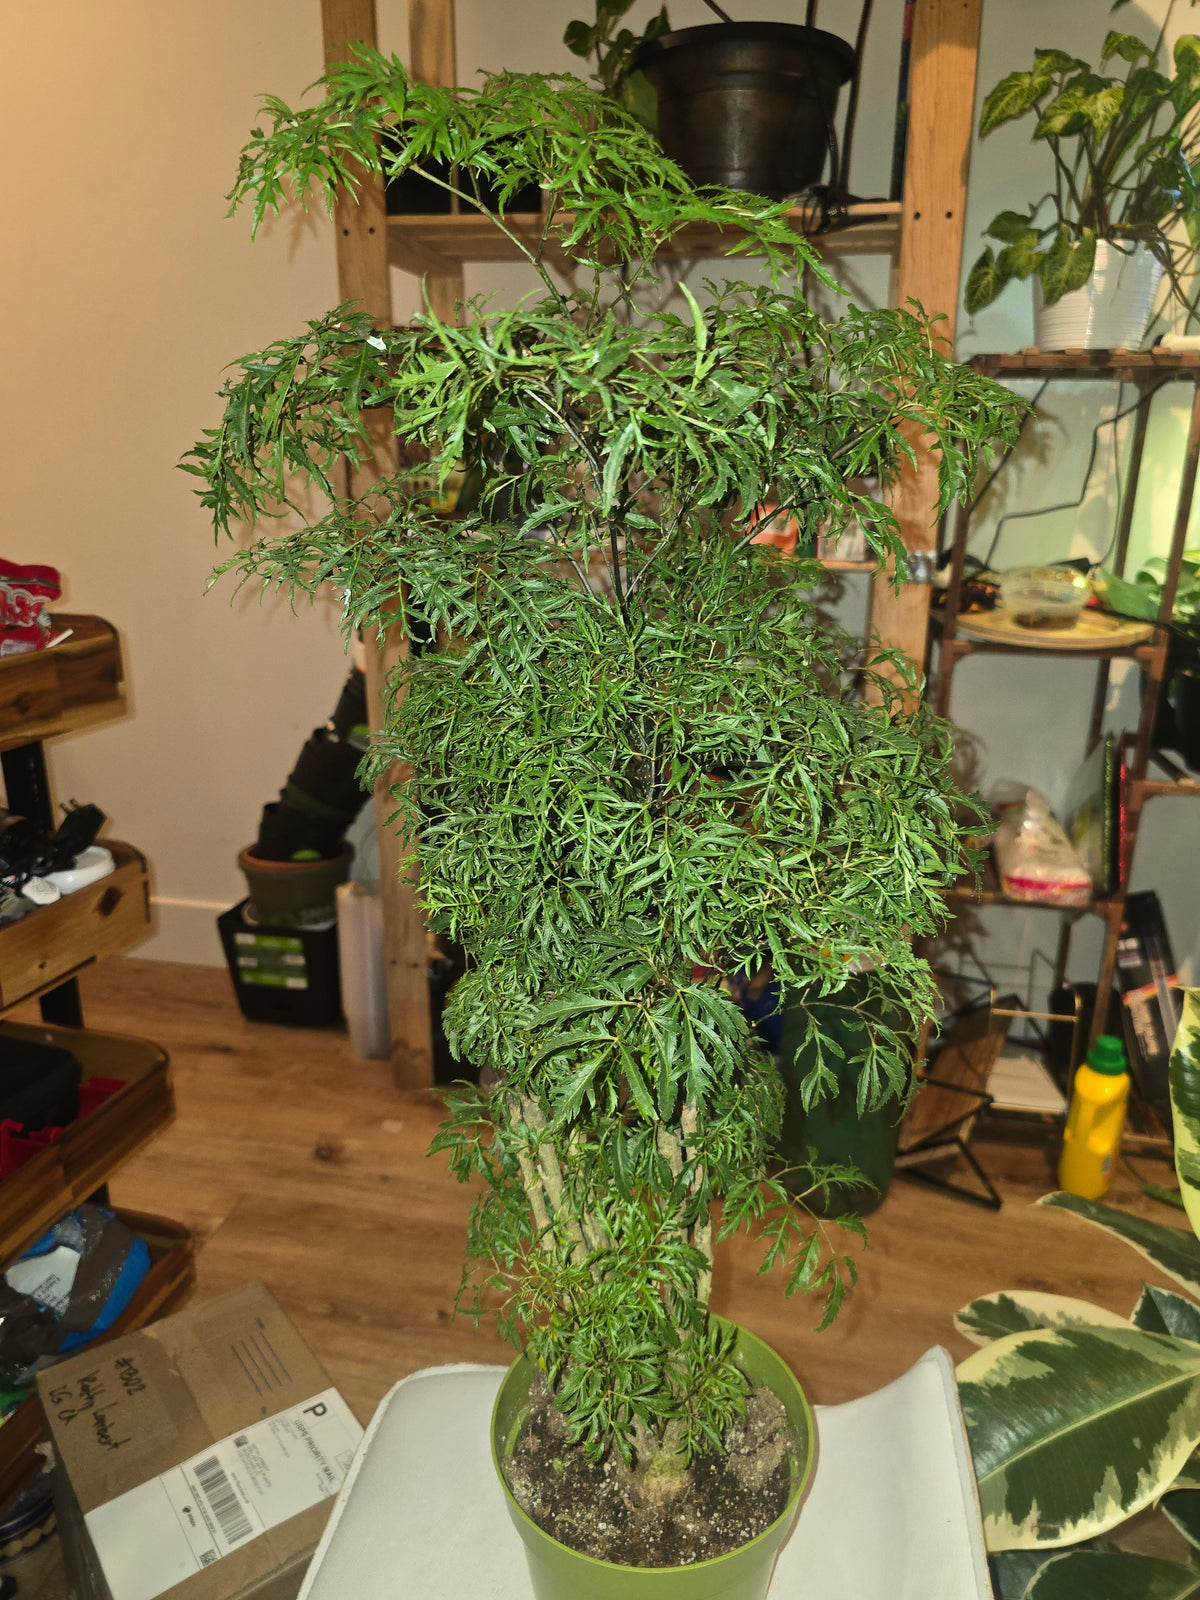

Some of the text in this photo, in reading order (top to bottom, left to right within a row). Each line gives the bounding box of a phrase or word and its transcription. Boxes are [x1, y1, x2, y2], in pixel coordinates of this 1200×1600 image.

[303, 1402, 327, 1416] P
[305, 1437, 325, 1466] PRIORITY
[322, 1466, 336, 1483] MAIL
